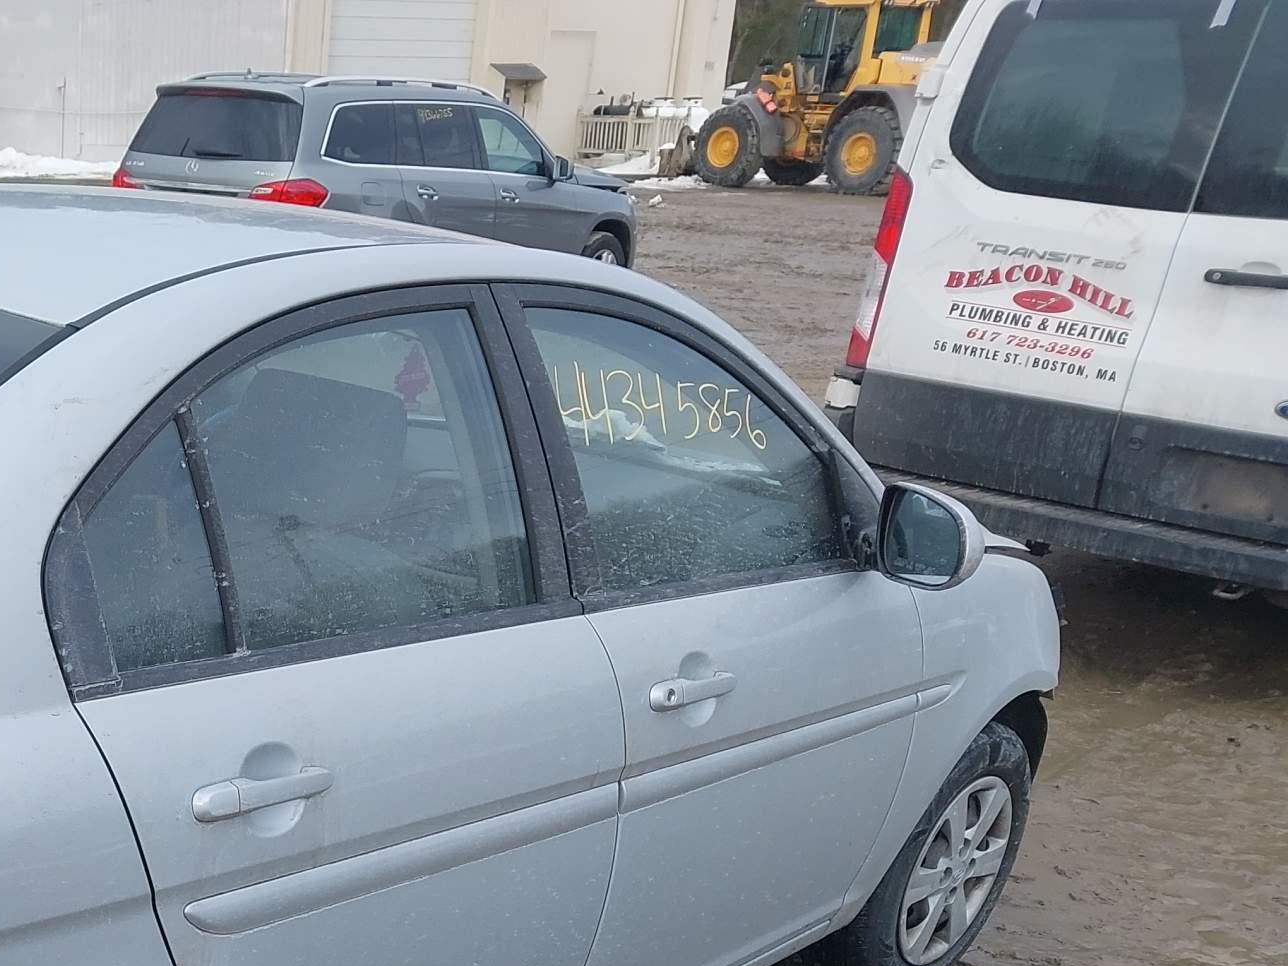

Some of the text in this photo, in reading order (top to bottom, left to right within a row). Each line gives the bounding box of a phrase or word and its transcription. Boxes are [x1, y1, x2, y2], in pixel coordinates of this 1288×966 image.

[976, 241, 1091, 265] TRANSIT
[944, 263, 1136, 319] BEACON HILL
[948, 302, 1129, 346] PLUMBING & HEATING
[966, 327, 1095, 360] 617 723-3296
[933, 339, 947, 352] 56
[951, 343, 1000, 361] MYRTLE
[1003, 352, 1022, 366] ST.
[1032, 356, 1089, 379] BOSTON,
[1096, 368, 1117, 382] MA
[554, 360, 767, 450] 44345856
